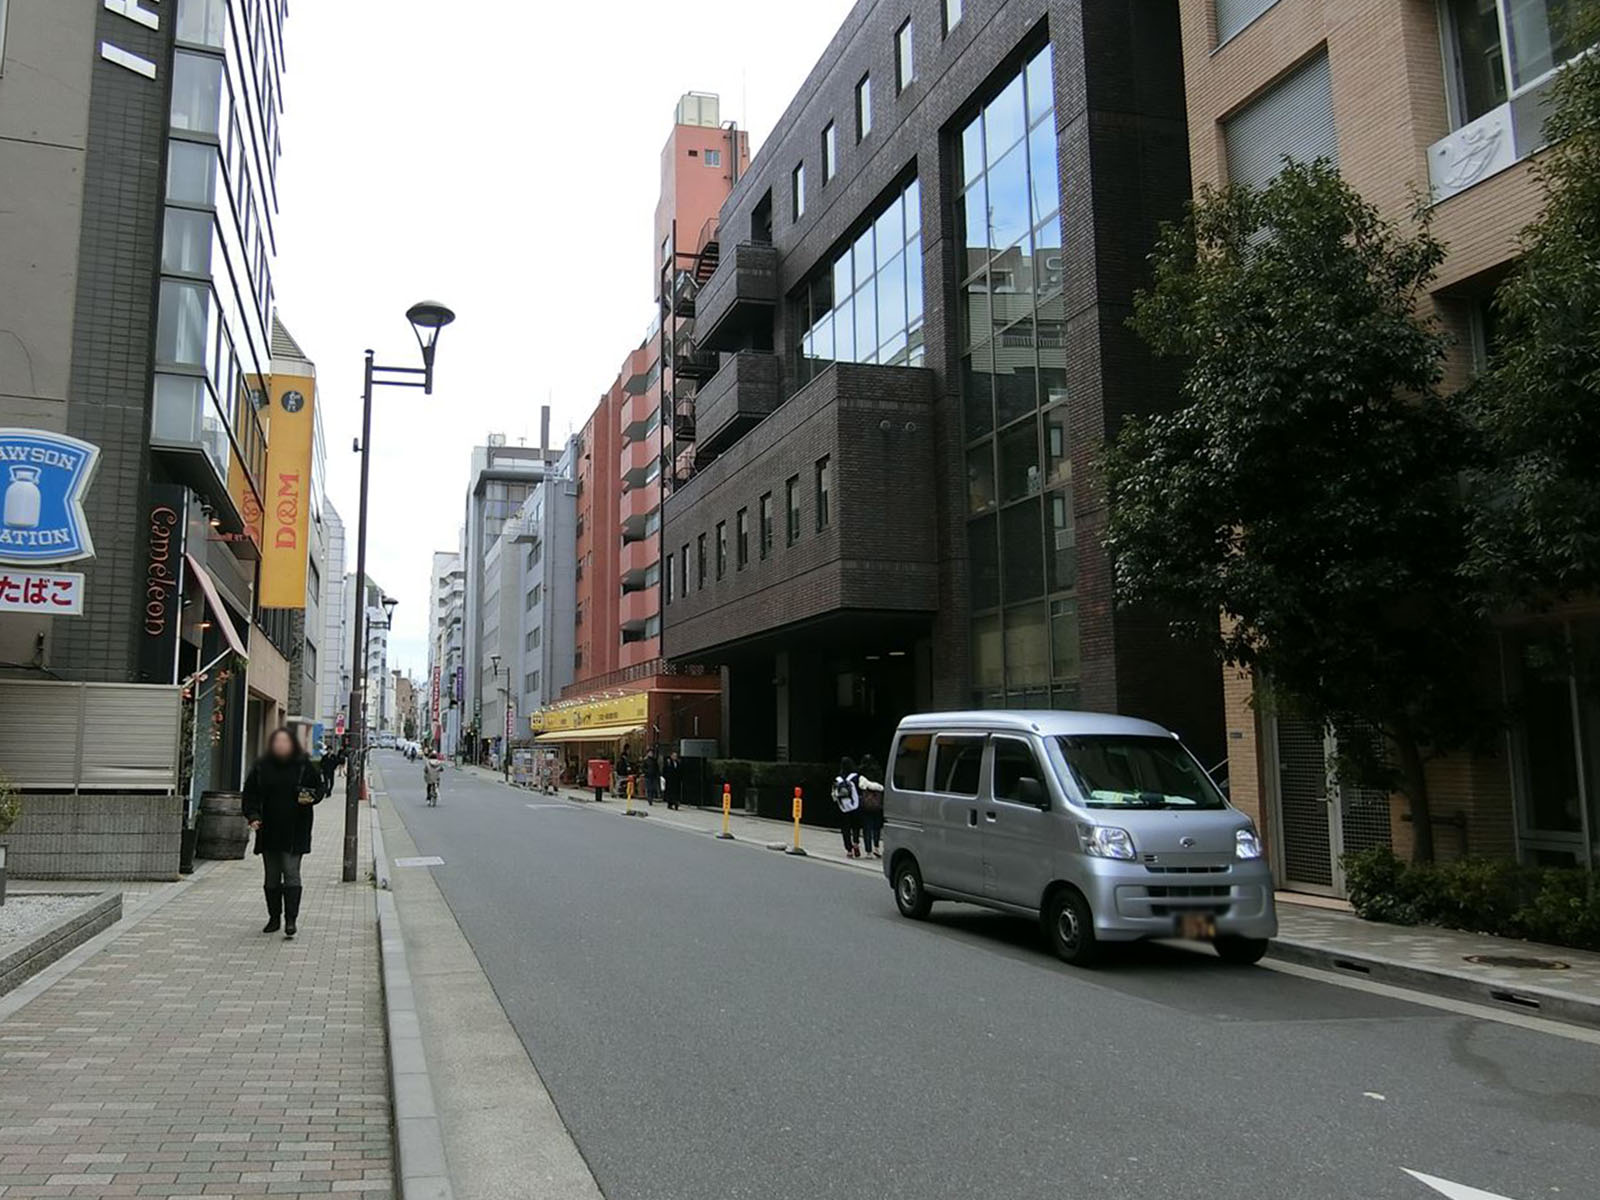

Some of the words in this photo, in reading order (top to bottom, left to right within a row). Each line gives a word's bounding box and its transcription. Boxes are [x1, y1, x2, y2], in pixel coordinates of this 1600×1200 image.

[276, 474, 301, 549] D&M
[0, 576, 72, 606] たばこ
